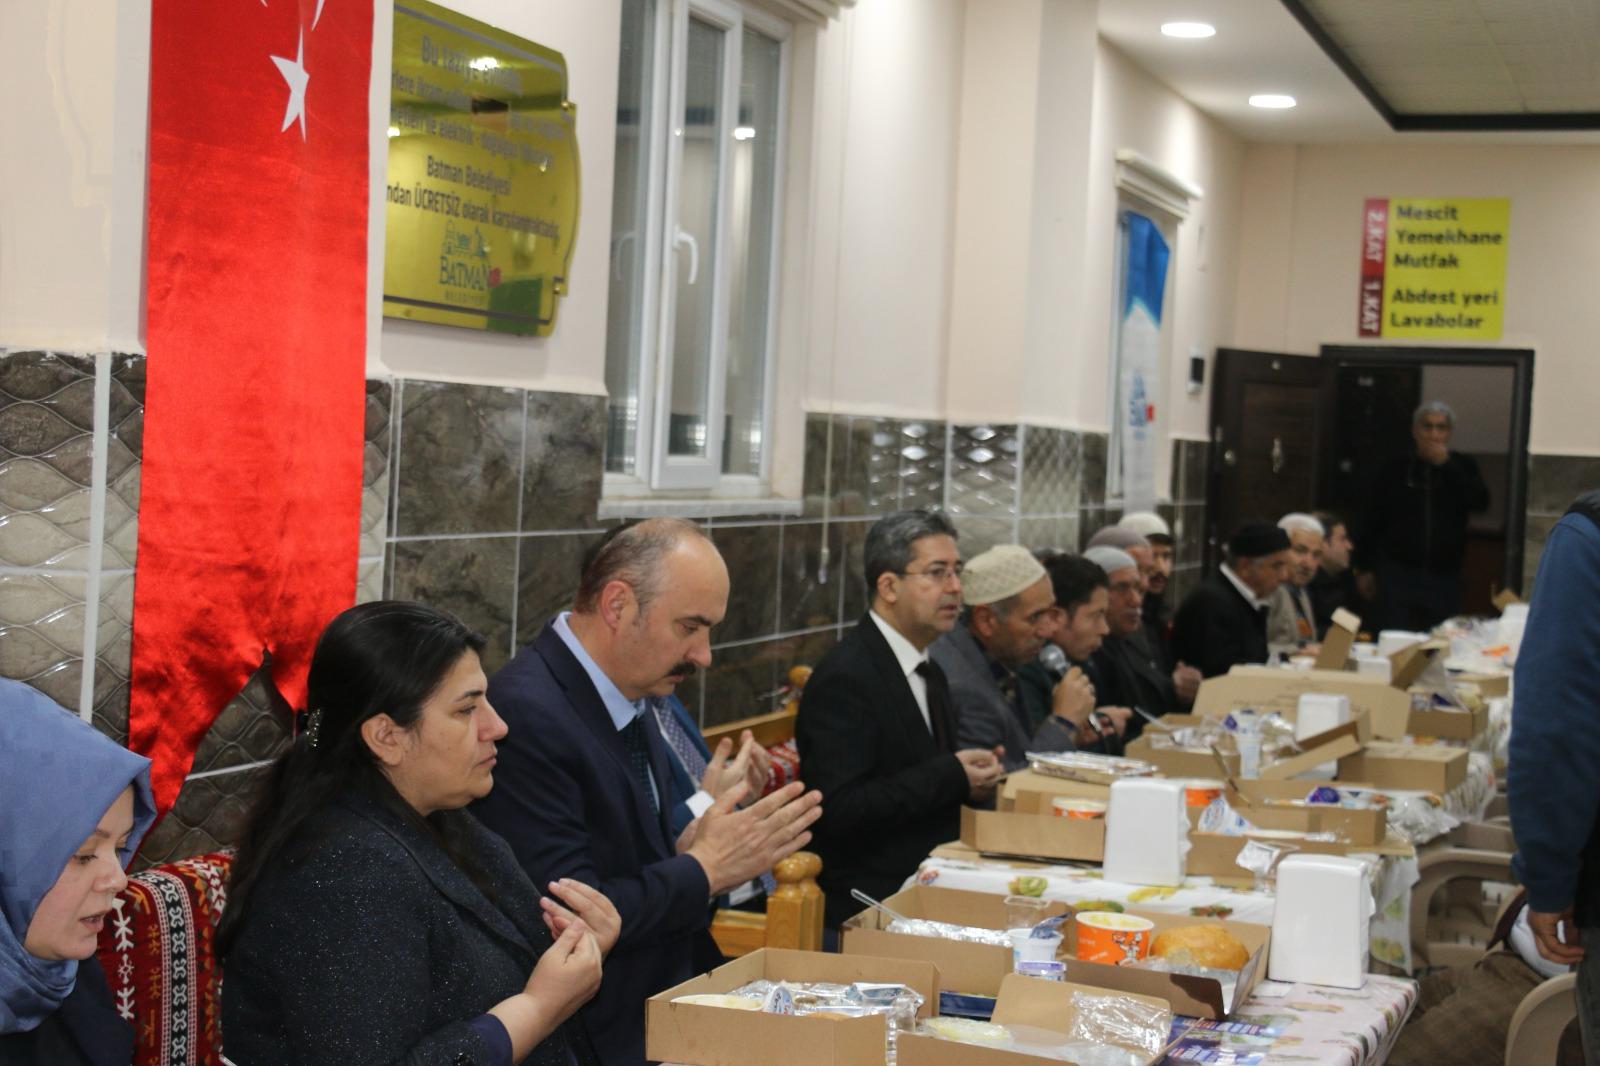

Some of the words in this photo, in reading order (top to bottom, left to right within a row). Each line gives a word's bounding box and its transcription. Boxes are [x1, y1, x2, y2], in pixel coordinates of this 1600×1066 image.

[421, 34, 439, 65] Bu
[428, 155, 463, 184] Batman
[415, 182, 461, 218] ÜCRETSİZ
[1397, 206, 1459, 221] Mescit
[1367, 210, 1384, 263] 2.KAT
[1396, 230, 1503, 245] Yemekhane
[440, 255, 490, 292] BATMAN
[1394, 254, 1459, 268] Mutfak
[1361, 281, 1380, 333] 1.KAT
[1393, 289, 1457, 304] Abdest
[1462, 291, 1498, 307] yeri
[1391, 313, 1484, 328] Lavabolar
